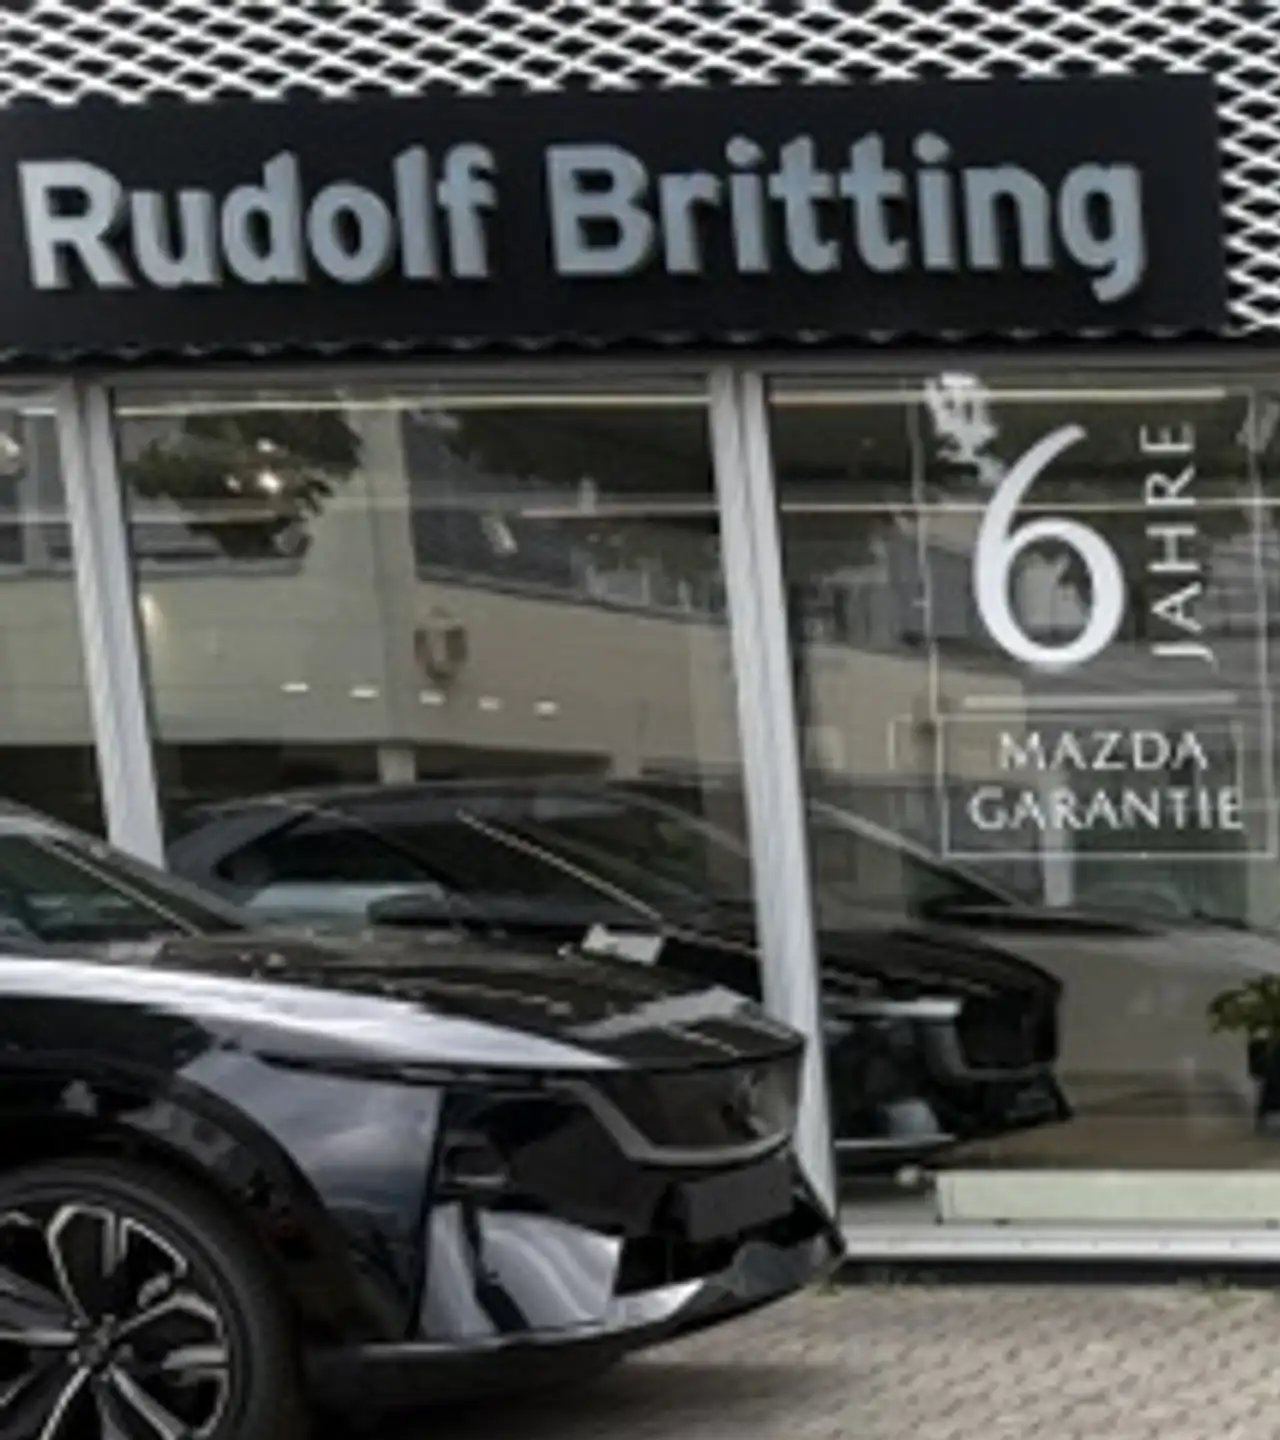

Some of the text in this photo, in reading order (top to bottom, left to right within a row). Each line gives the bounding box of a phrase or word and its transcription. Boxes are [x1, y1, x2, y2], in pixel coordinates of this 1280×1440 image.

[18, 133, 1145, 303] Rudolf Britting
[974, 424, 1125, 669] 6
[1140, 421, 1219, 672] JAHRE
[967, 786, 1246, 830] GARANTIE
[997, 731, 1210, 771] MAZDA
